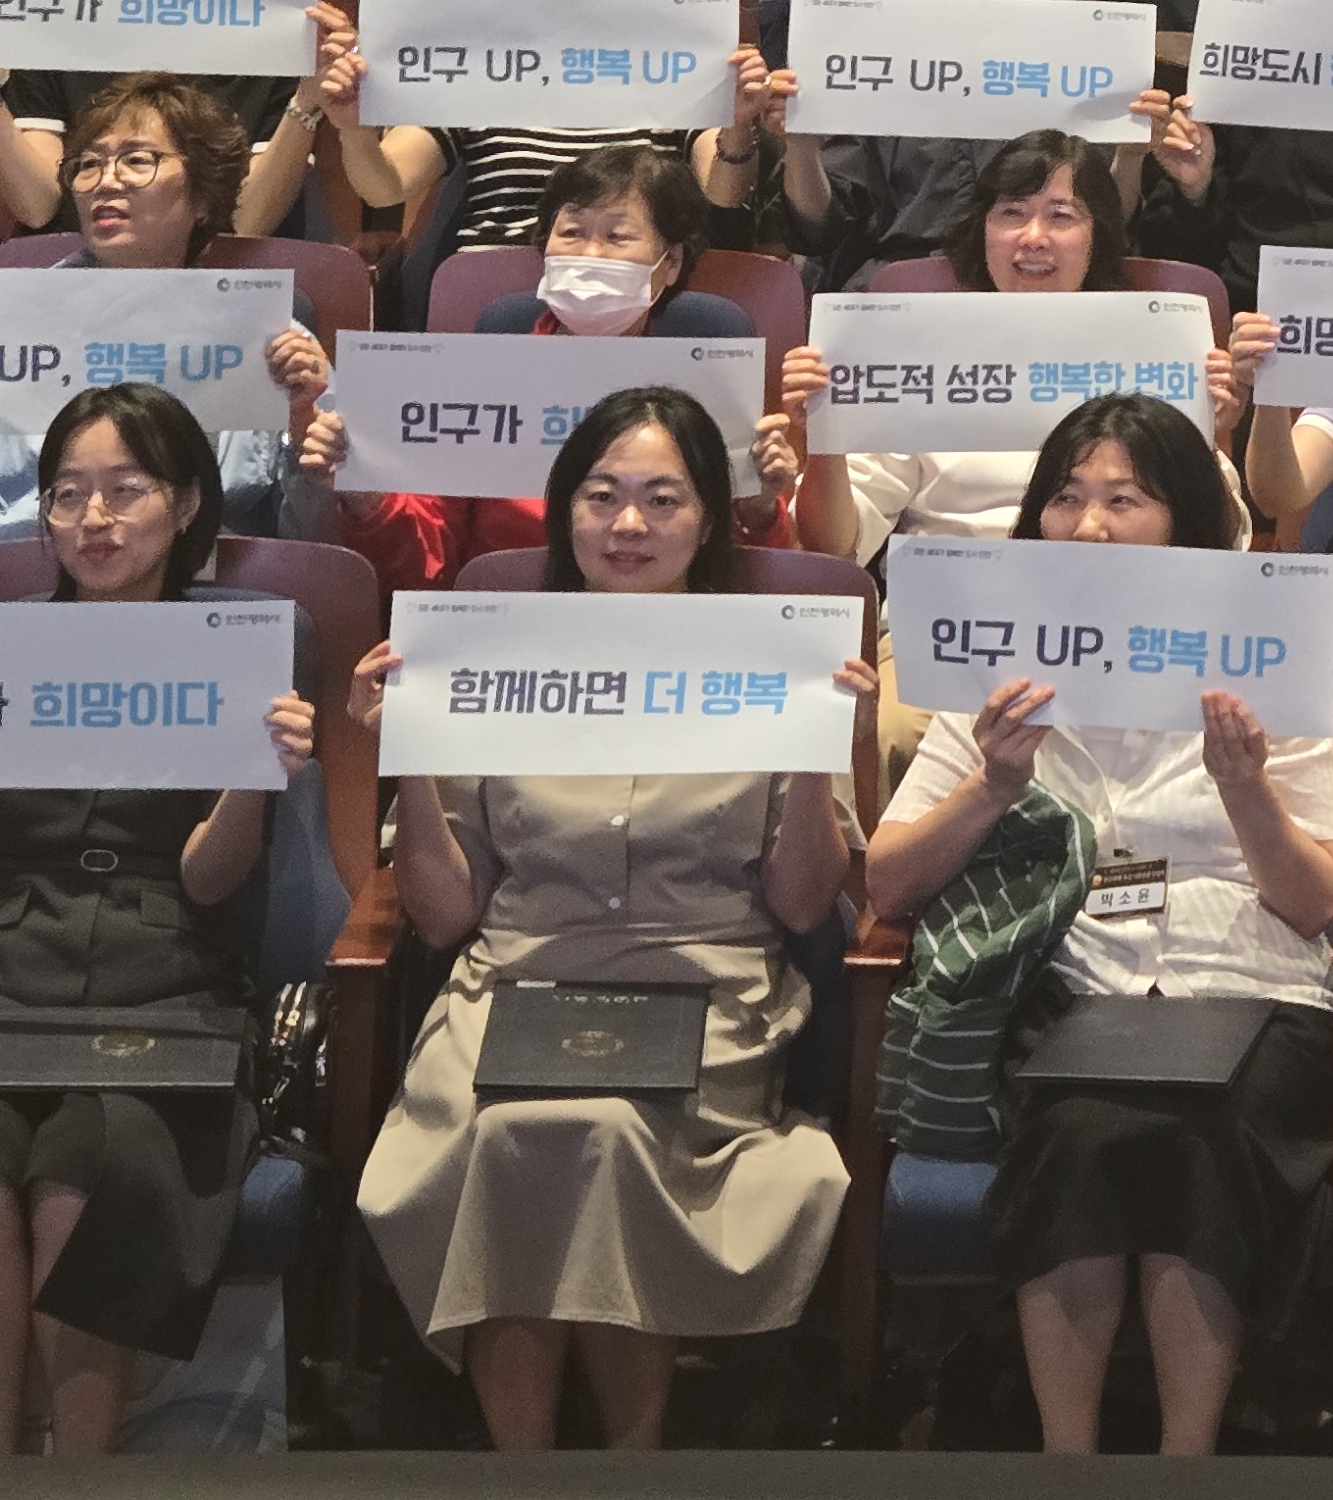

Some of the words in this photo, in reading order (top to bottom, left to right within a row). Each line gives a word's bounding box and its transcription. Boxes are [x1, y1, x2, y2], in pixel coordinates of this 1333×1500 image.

[398, 45, 469, 84] 인구
[486, 48, 550, 86] UP,
[561, 47, 632, 85] 행복
[642, 51, 696, 84] UP
[1199, 42, 1322, 85] 희망도시
[931, 618, 1016, 667] 인구
[1036, 623, 1113, 673] UP,
[1128, 625, 1208, 677] 행복
[1220, 635, 1286, 677] UP
[31, 681, 224, 728] 희망이다
[448, 667, 627, 715] 함께하면
[643, 671, 686, 714] 더
[701, 671, 787, 715] 행복
